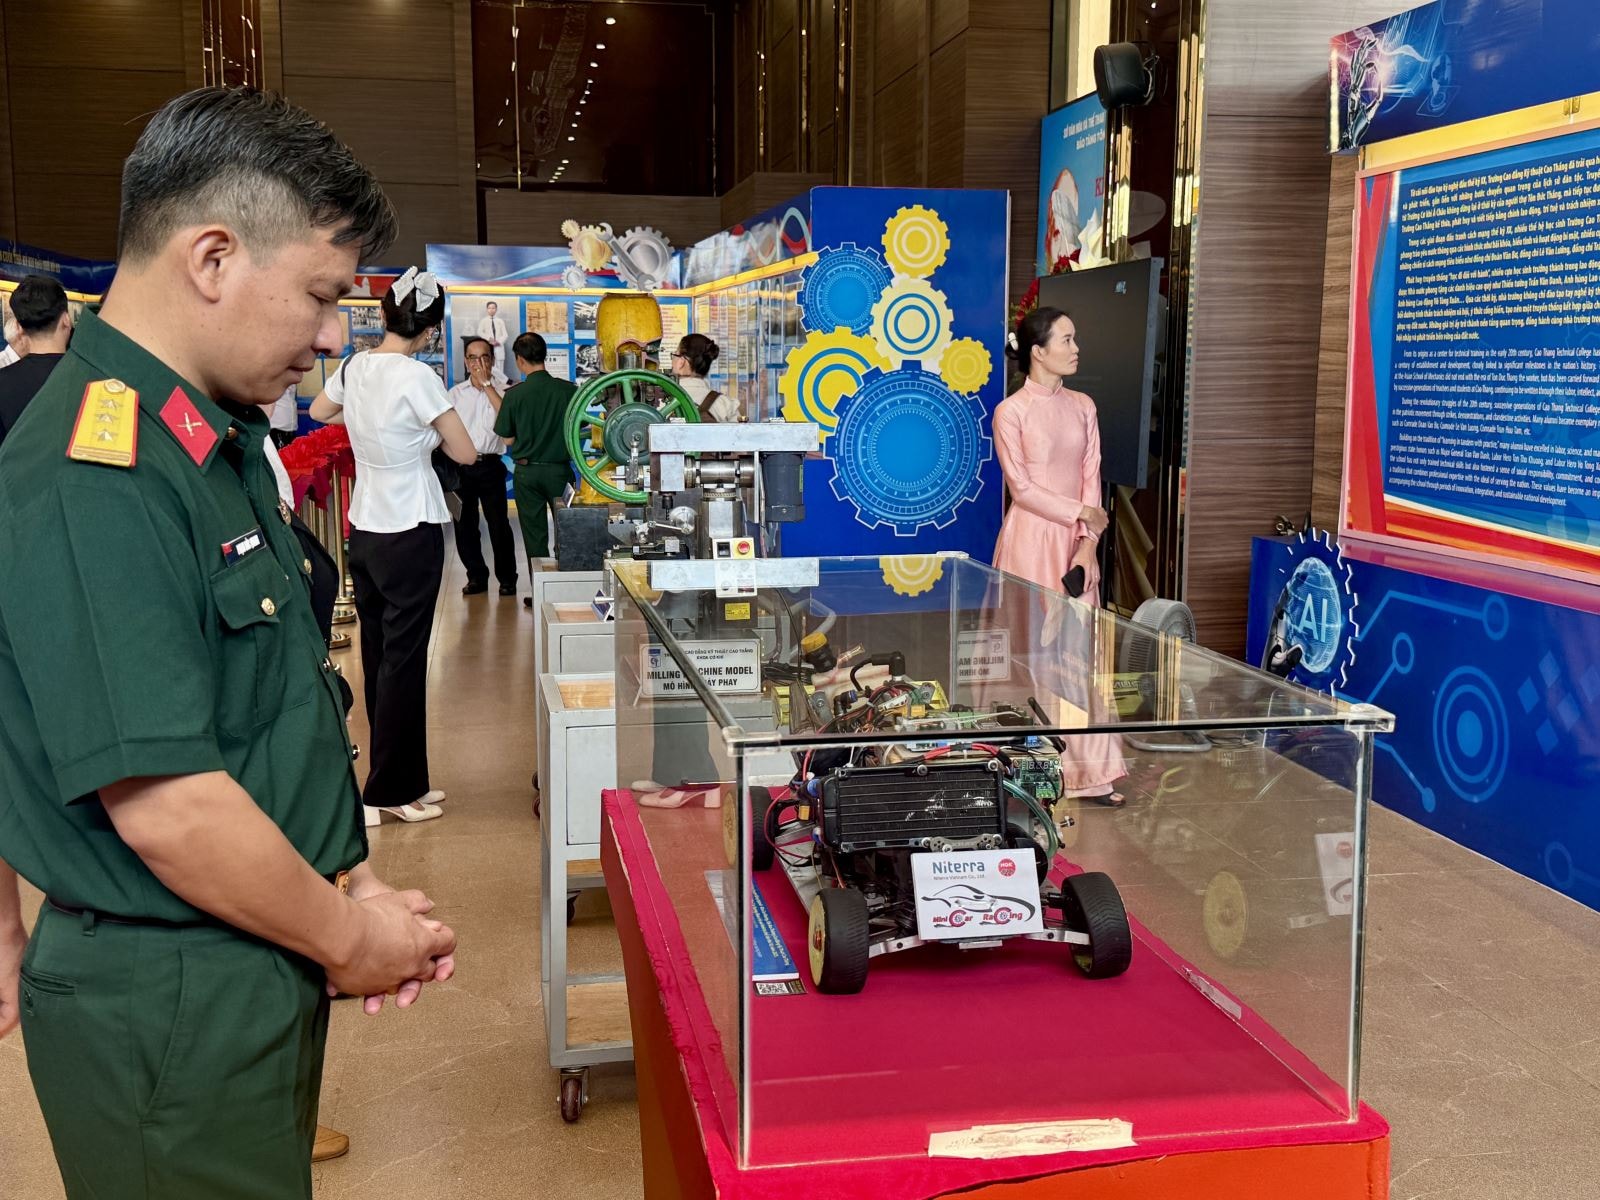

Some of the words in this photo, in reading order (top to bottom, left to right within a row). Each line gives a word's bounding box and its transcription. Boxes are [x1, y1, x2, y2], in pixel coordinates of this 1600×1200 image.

[1300, 593, 1328, 642] AI
[647, 671, 680, 680] MILLING
[726, 666, 753, 675] MODEL
[932, 861, 985, 874] Niterra
